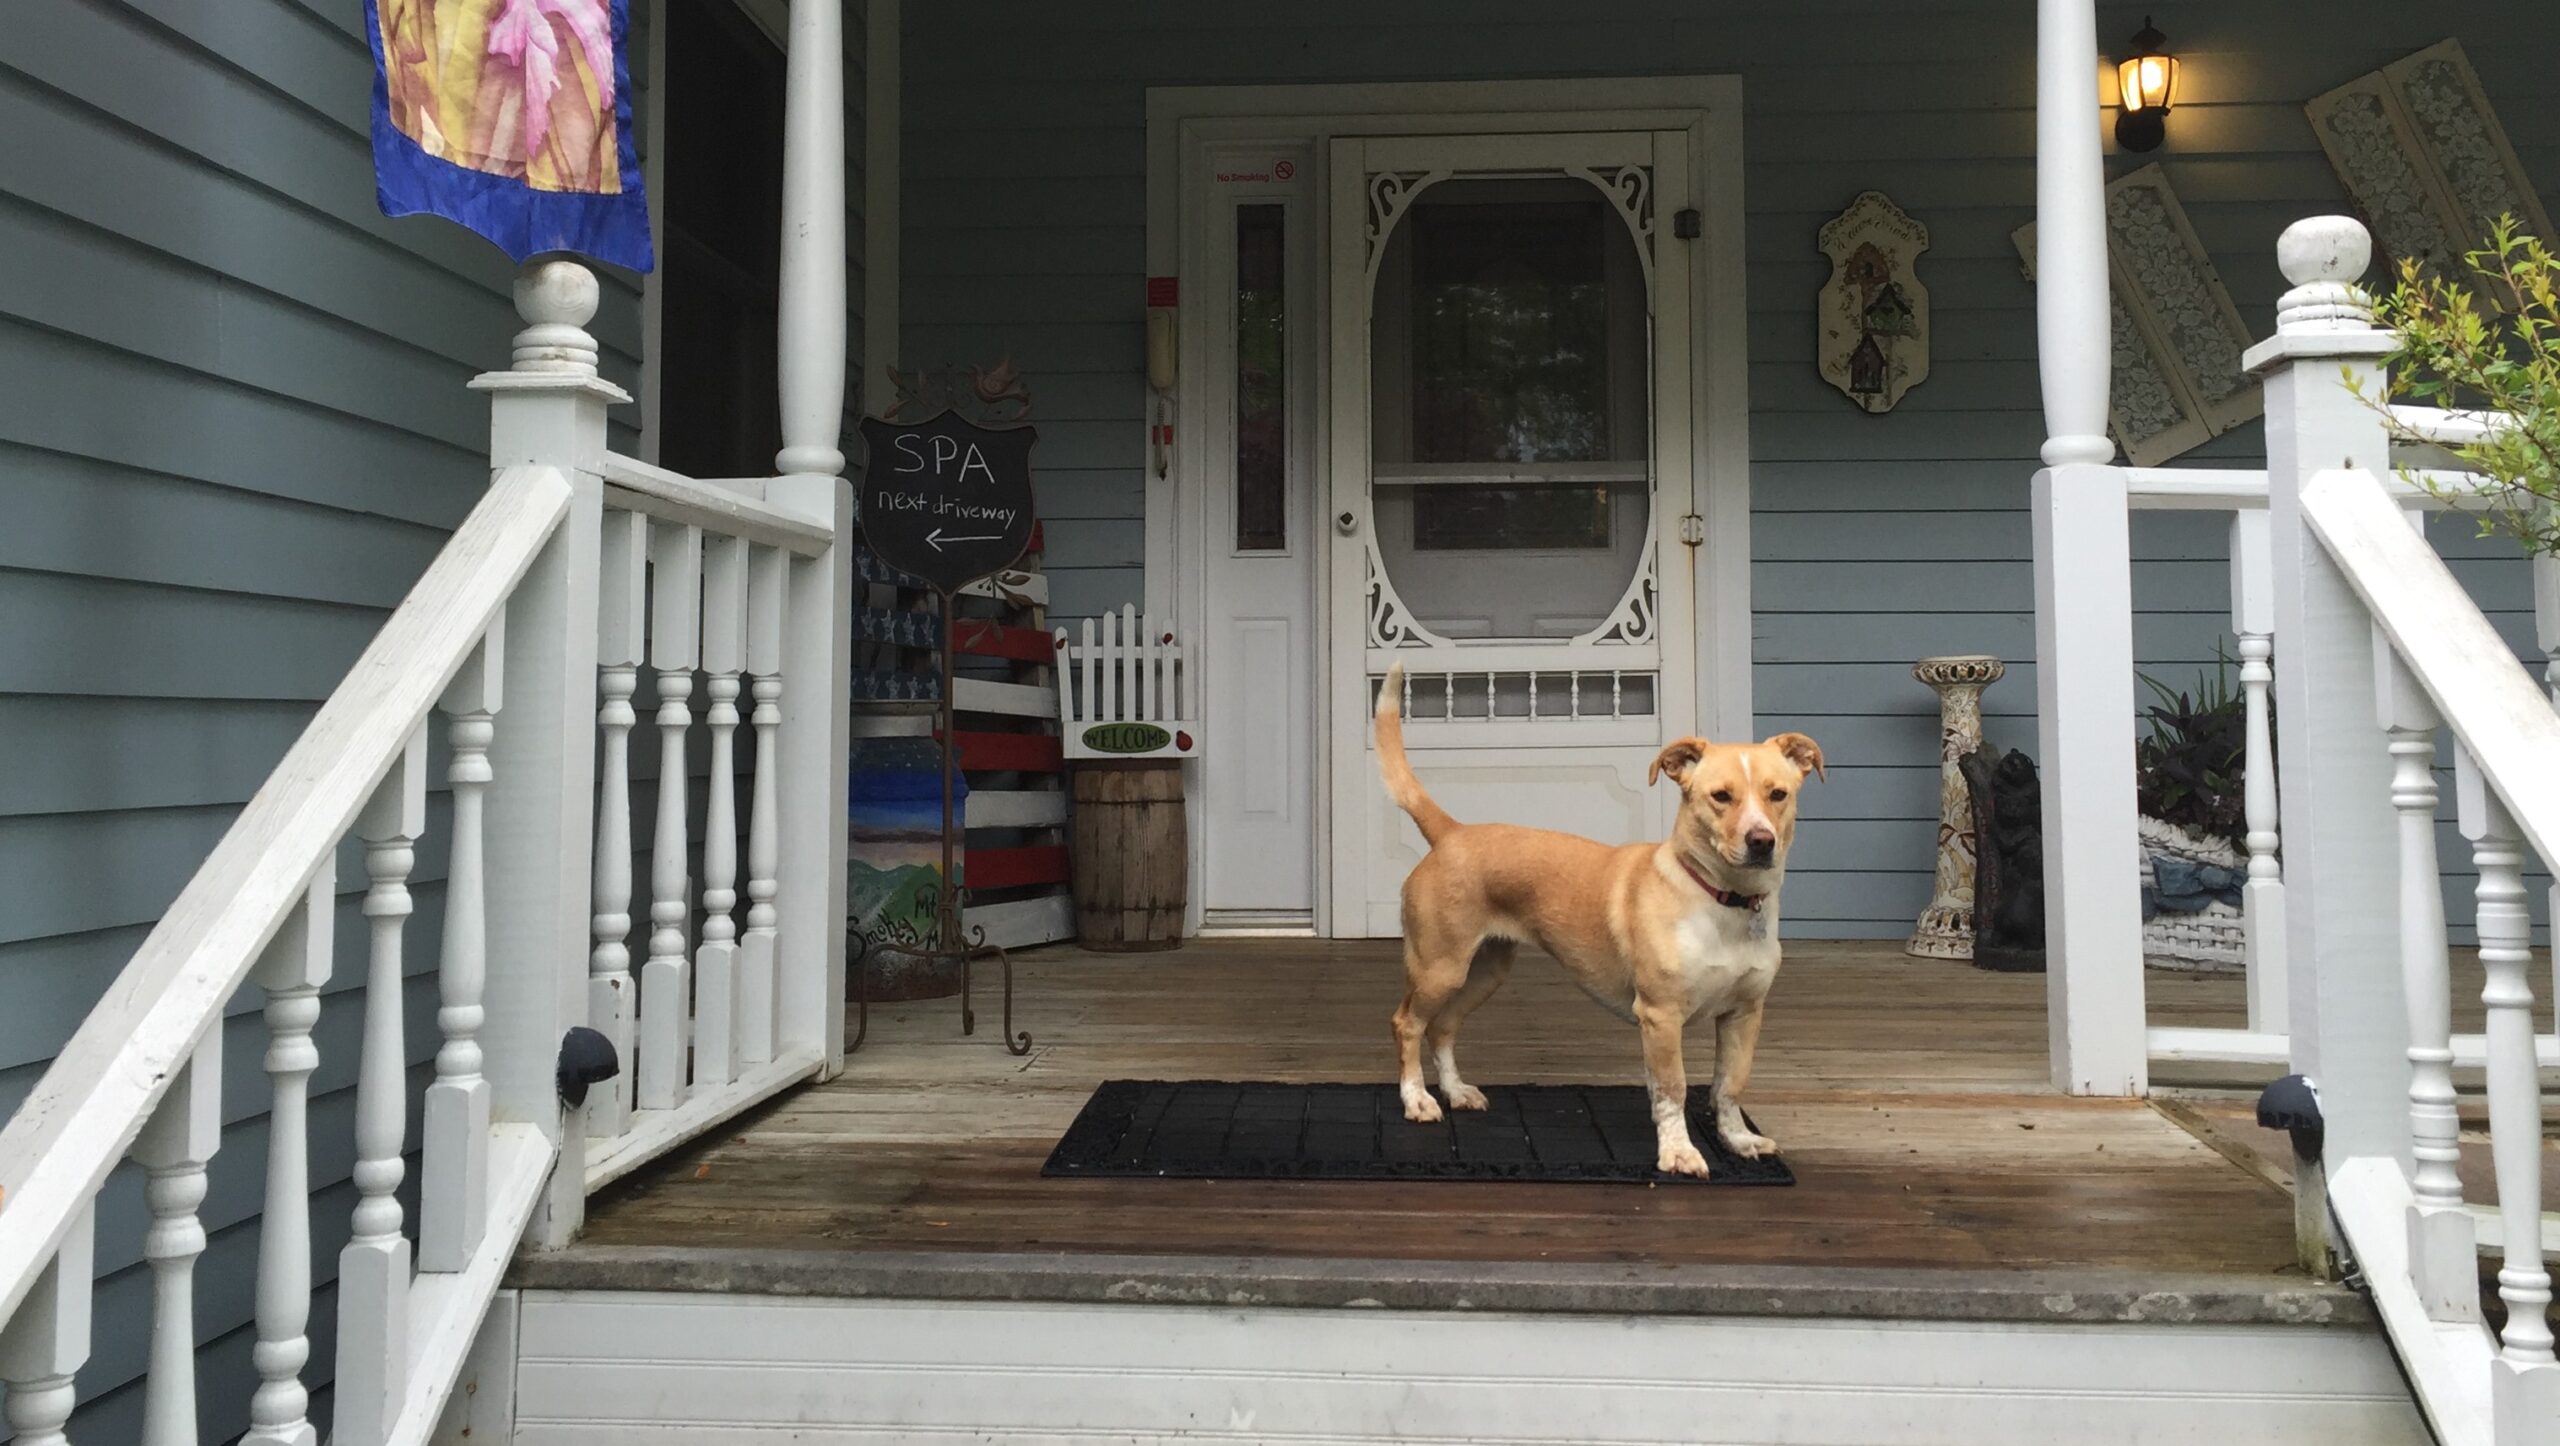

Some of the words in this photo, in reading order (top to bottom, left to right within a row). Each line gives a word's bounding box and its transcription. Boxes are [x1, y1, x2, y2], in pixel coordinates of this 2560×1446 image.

[1216, 173, 1229, 182] No
[1231, 173, 1269, 183] Smoking
[894, 433, 995, 484] SPA
[878, 490, 928, 511] next
[932, 494, 1016, 531] driveway
[1086, 727, 1167, 749] WELCOME
